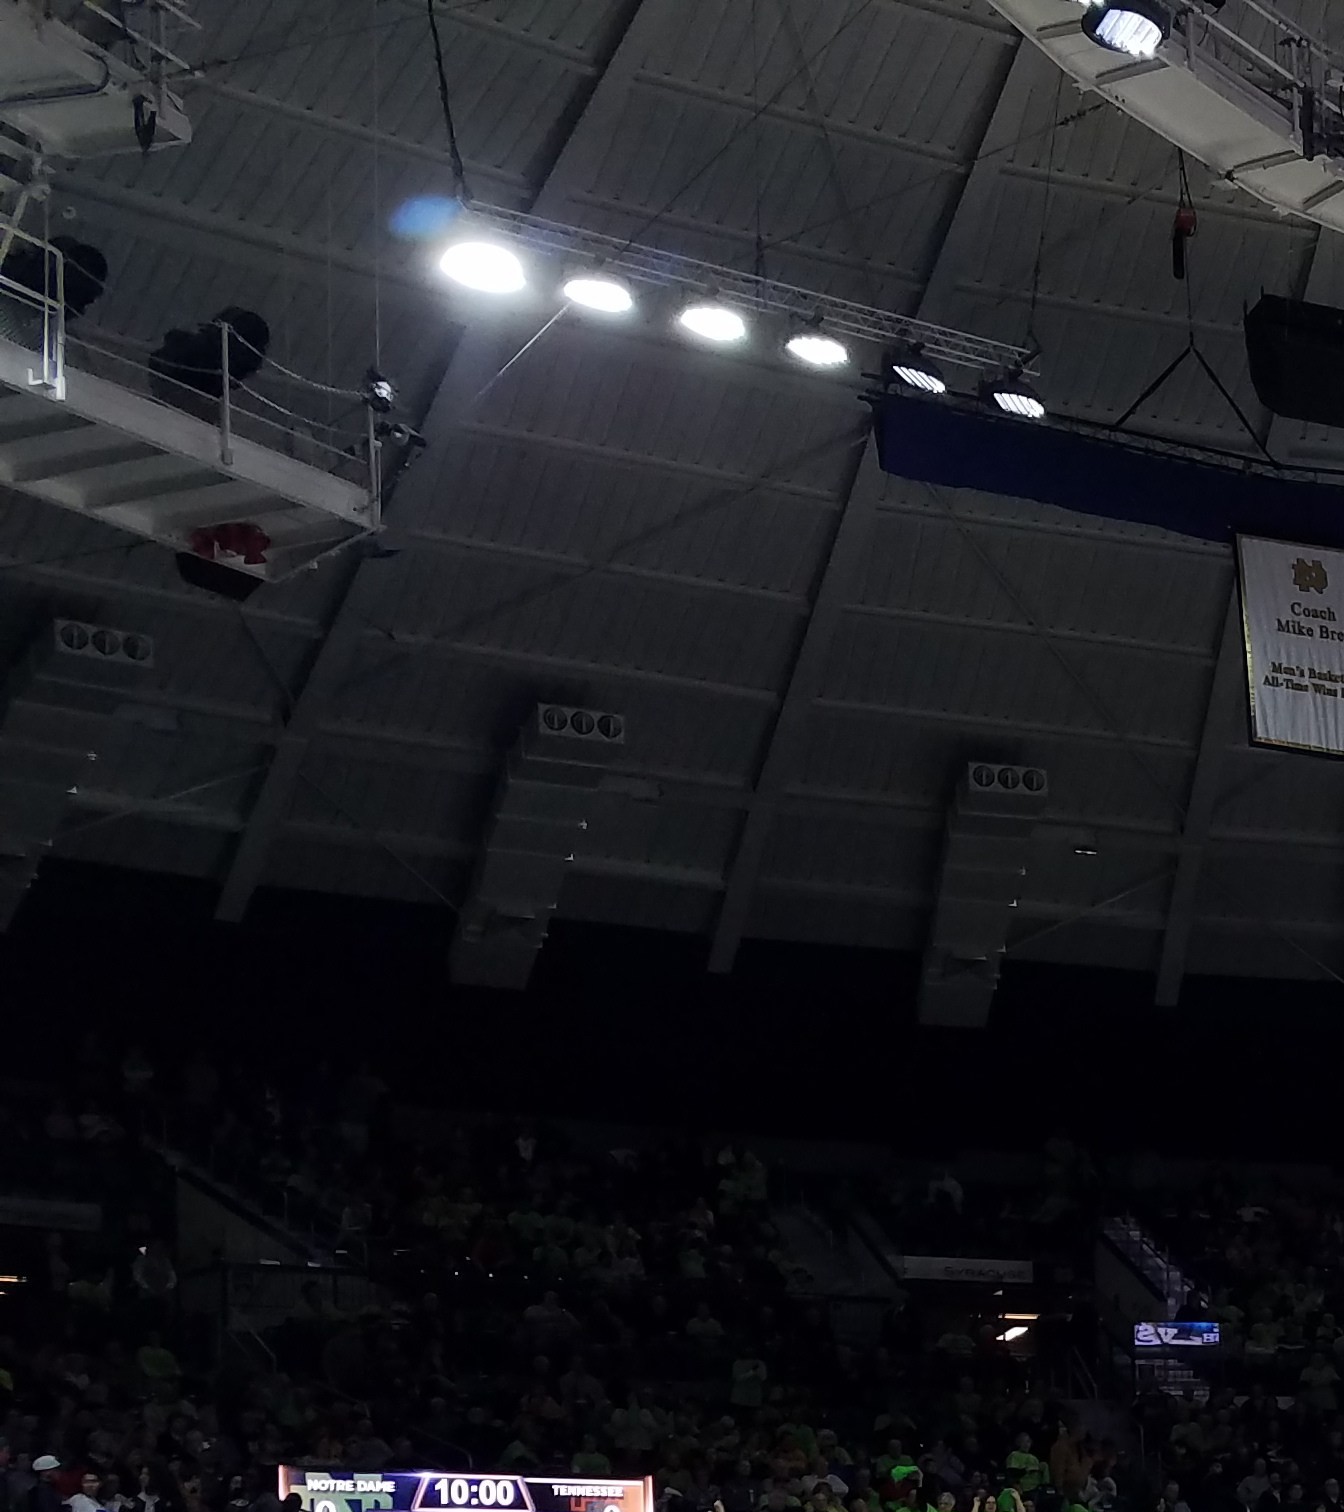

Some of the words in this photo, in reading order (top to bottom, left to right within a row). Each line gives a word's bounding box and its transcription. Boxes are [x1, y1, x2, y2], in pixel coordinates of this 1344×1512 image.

[1291, 602, 1336, 621] Coach
[1276, 618, 1314, 637] Mike
[1271, 661, 1305, 678] Men's
[1263, 676, 1308, 692] All-Time
[1312, 682, 1338, 697] Wins
[307, 1479, 354, 1491] NOTRE
[357, 1480, 396, 1493] DAME
[434, 1478, 514, 1506] 10:00
[552, 1485, 625, 1498] TENNESSEE
